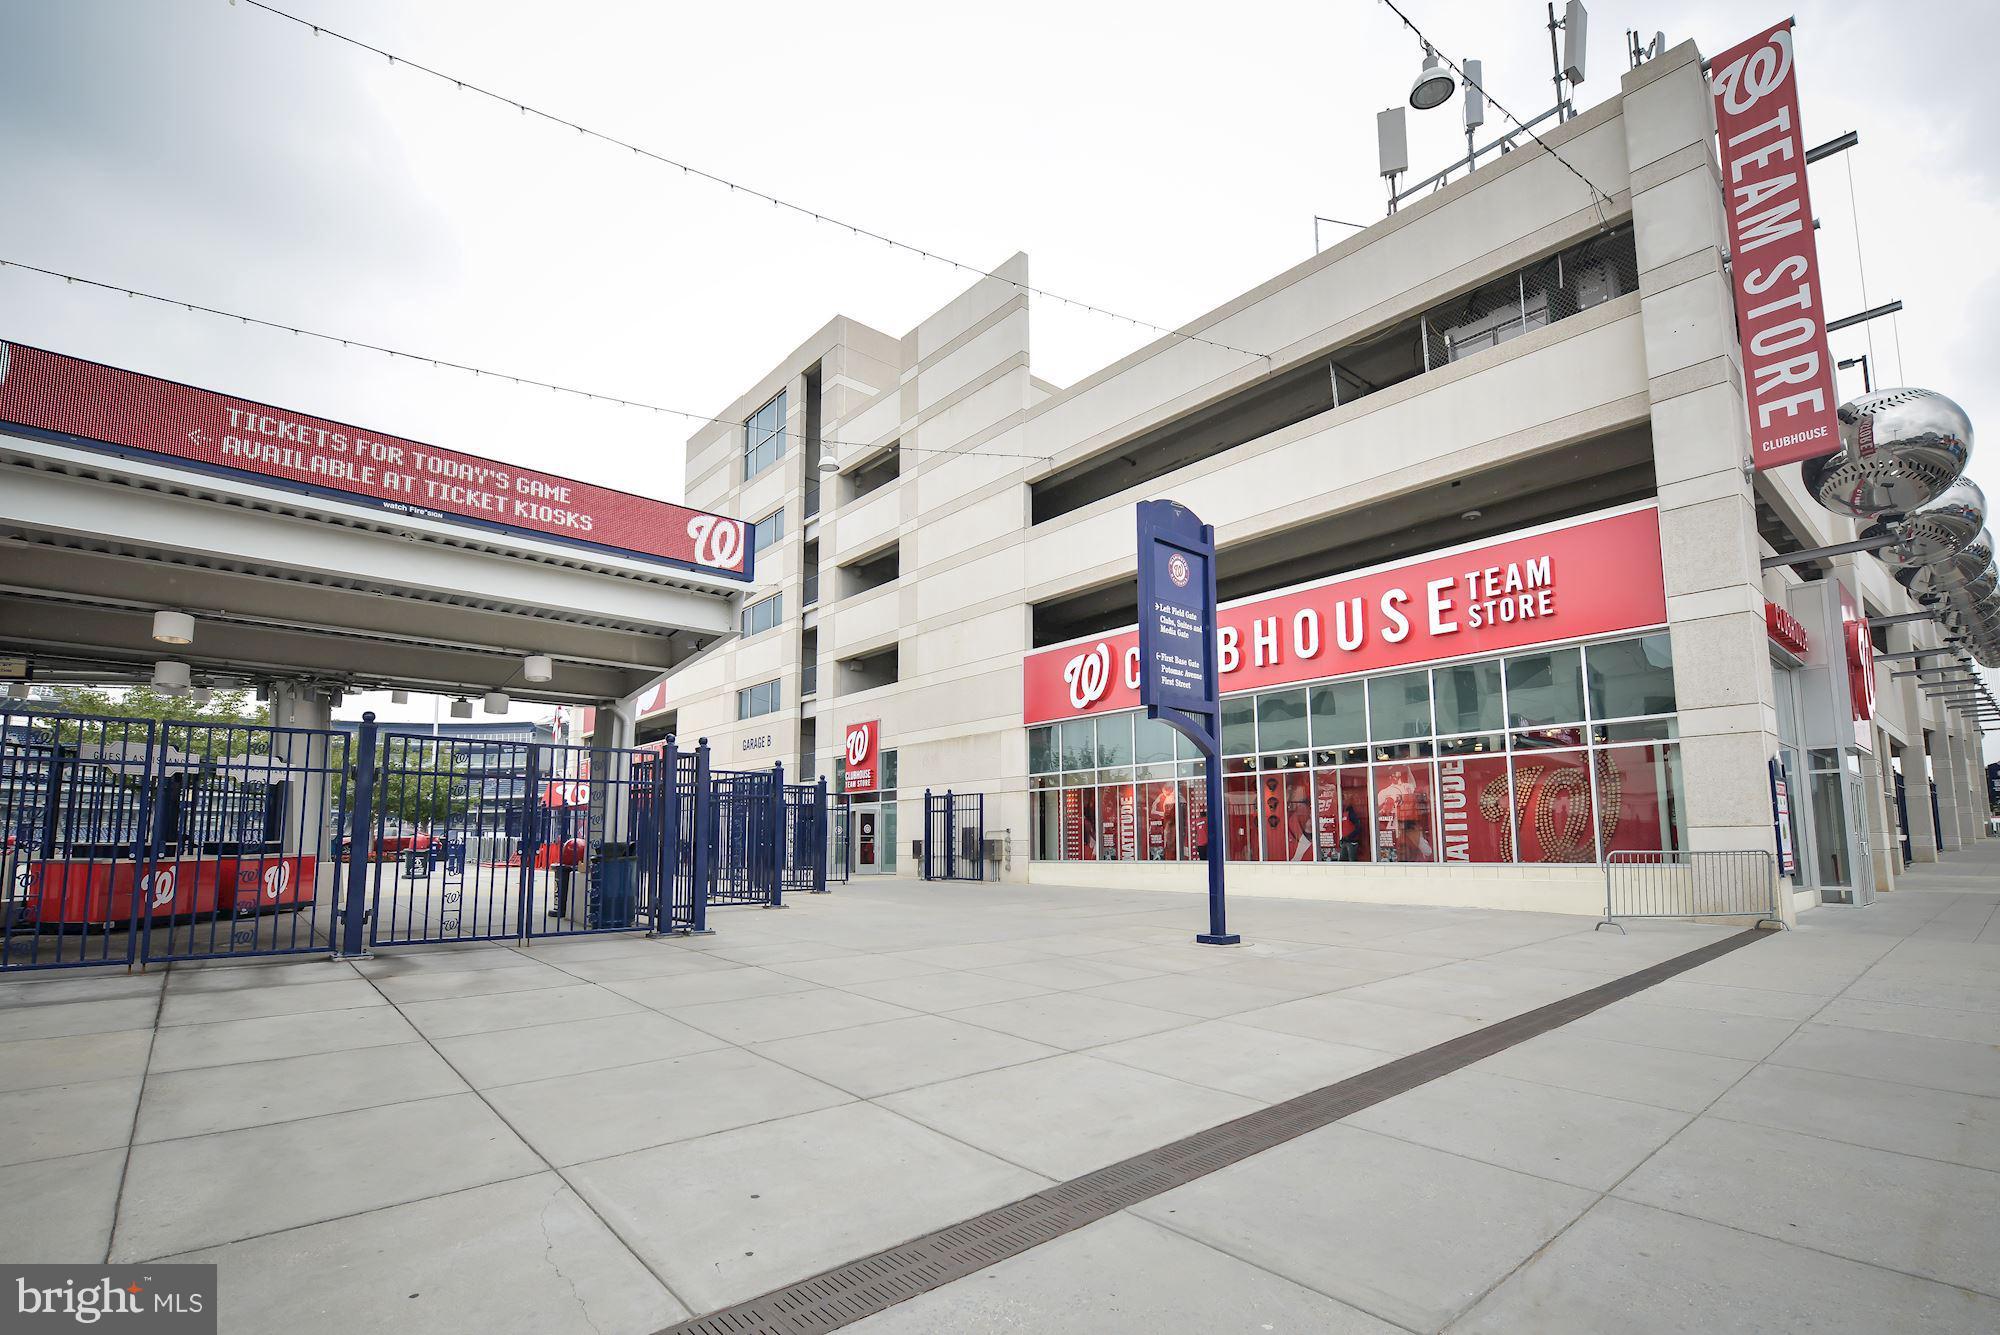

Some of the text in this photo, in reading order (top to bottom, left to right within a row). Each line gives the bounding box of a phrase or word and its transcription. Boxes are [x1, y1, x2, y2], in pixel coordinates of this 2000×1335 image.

[1713, 29, 1793, 116] W
[1728, 105, 1826, 429] TEAM STORE
[1762, 425, 1828, 452] CLUBHOUSE
[226, 407, 347, 452] TICKETS
[356, 438, 404, 466] FOR
[516, 476, 571, 504] GAME
[222, 435, 593, 531] AVAILABLE AT TICKET KIOSKS
[687, 514, 743, 569] W
[1465, 555, 1552, 602] TEAM
[1160, 603, 1197, 620] Left Field Gate
[1469, 589, 1554, 629] STORE
[1160, 625, 1189, 639] Media Gate
[1177, 619, 1192, 630] Suites
[1193, 625, 1202, 633] and
[1063, 577, 1458, 709] W CBHOUSE
[1161, 652, 1199, 668] First Base Gate
[1161, 664, 1202, 680] Potomac Avenue
[1161, 676, 1191, 689] First Street
[742, 735, 772, 751] GARAGE B
[847, 725, 869, 766] W
[845, 779, 871, 788] TEAM STORE
